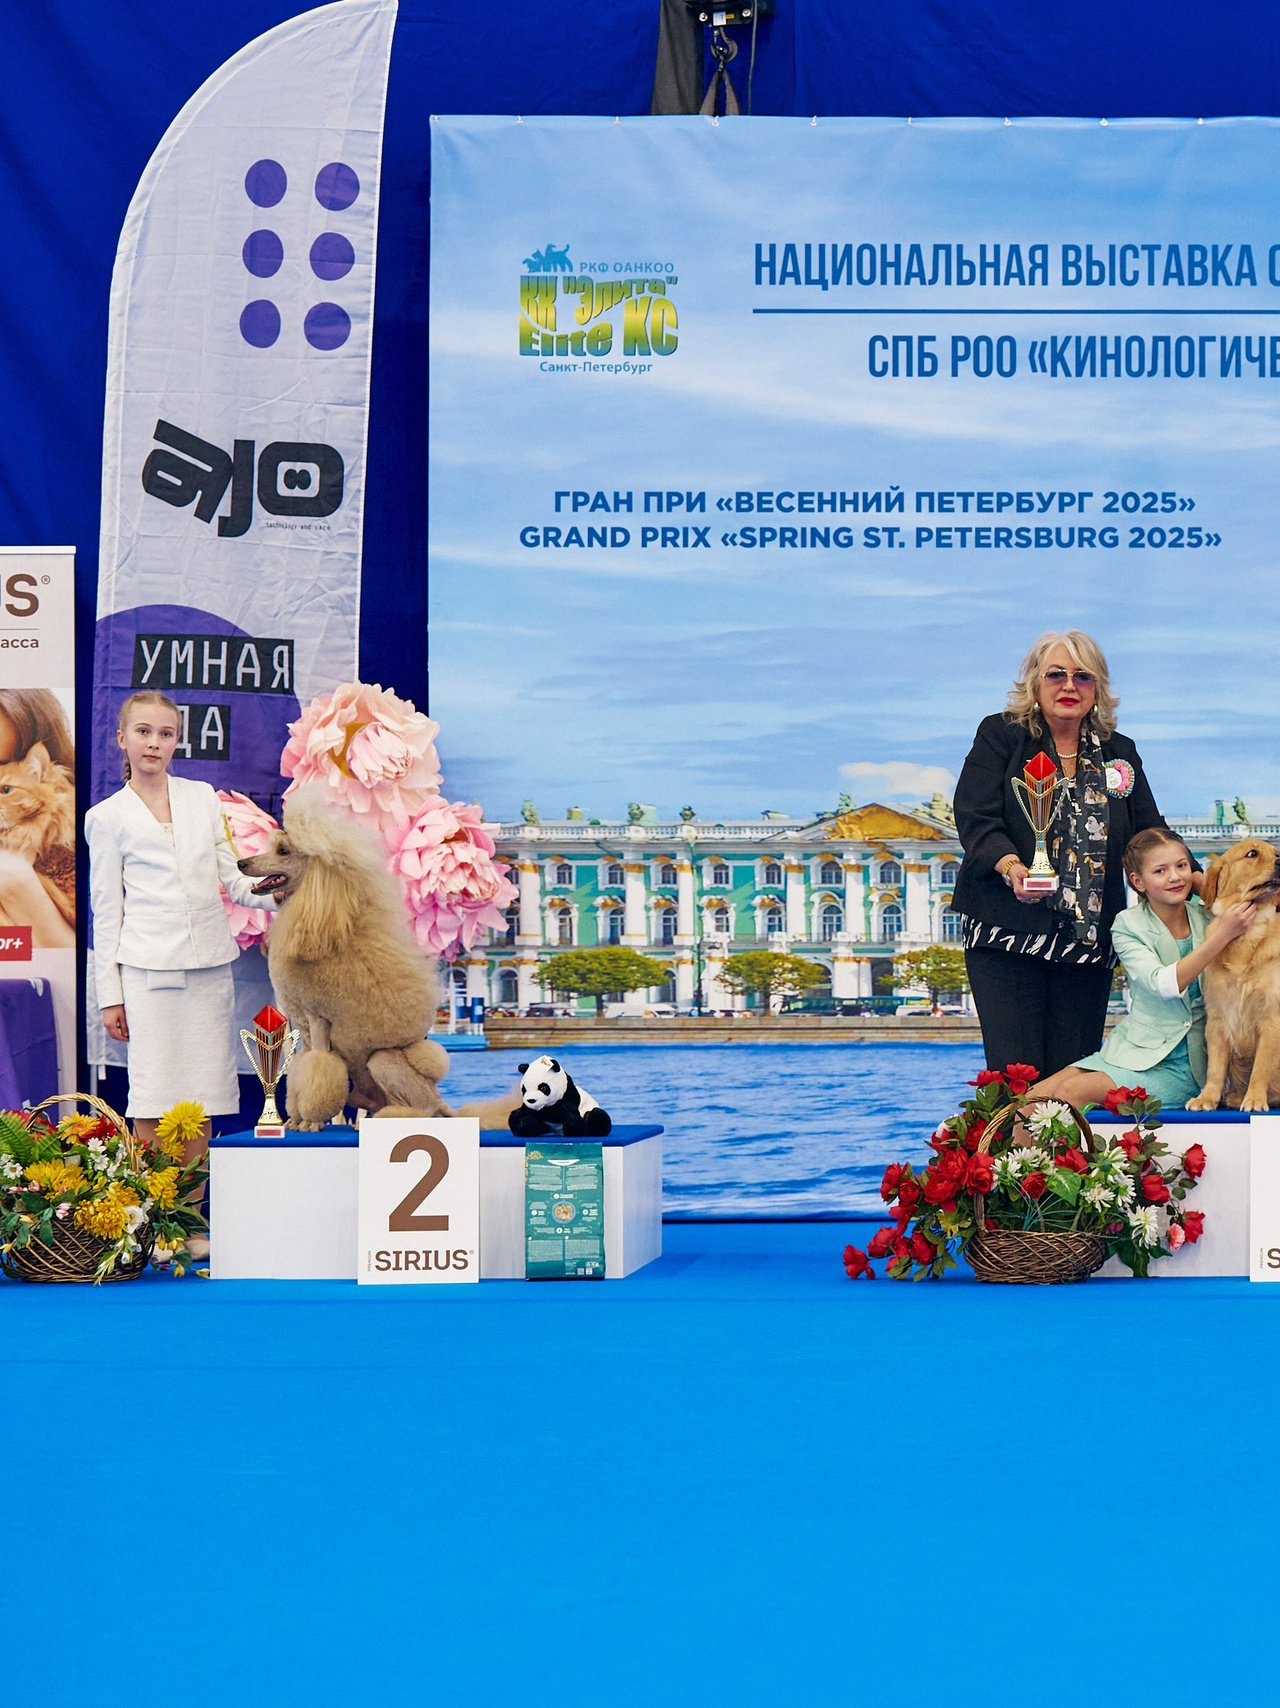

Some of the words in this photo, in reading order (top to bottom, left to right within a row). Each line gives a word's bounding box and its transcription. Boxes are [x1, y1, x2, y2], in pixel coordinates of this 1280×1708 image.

[580, 262, 609, 273] РКФ
[613, 262, 675, 273] ОАНКОО
[754, 243, 1049, 291] НАЦИОНАЛЬНАЯ
[1061, 243, 1258, 287] ВЫСТАВКА
[519, 275, 558, 332] КК
[519, 312, 613, 357] Elite
[868, 334, 939, 378] СПБ
[951, 335, 1017, 378] РОО
[539, 361, 653, 375] Санкт-Петербург
[554, 491, 634, 513] ГРАН
[643, 491, 706, 513] ПРИ
[715, 485, 905, 513] «ВЕСЕННИЙ
[915, 491, 1094, 514] ПЕТЕРБУРГ
[1102, 491, 1196, 514] 2025»
[519, 525, 631, 548] GRAND
[641, 526, 712, 548] PRIX
[720, 526, 854, 549] «SPRING
[863, 526, 906, 549] ST.
[915, 526, 1120, 549] PETERSBURG
[1128, 526, 1222, 549] 2025»
[139, 639, 291, 690] УМНАЯ
[176, 705, 223, 758] ДА
[389, 1134, 449, 1232] 2
[375, 1249, 469, 1271] SIRIUS
